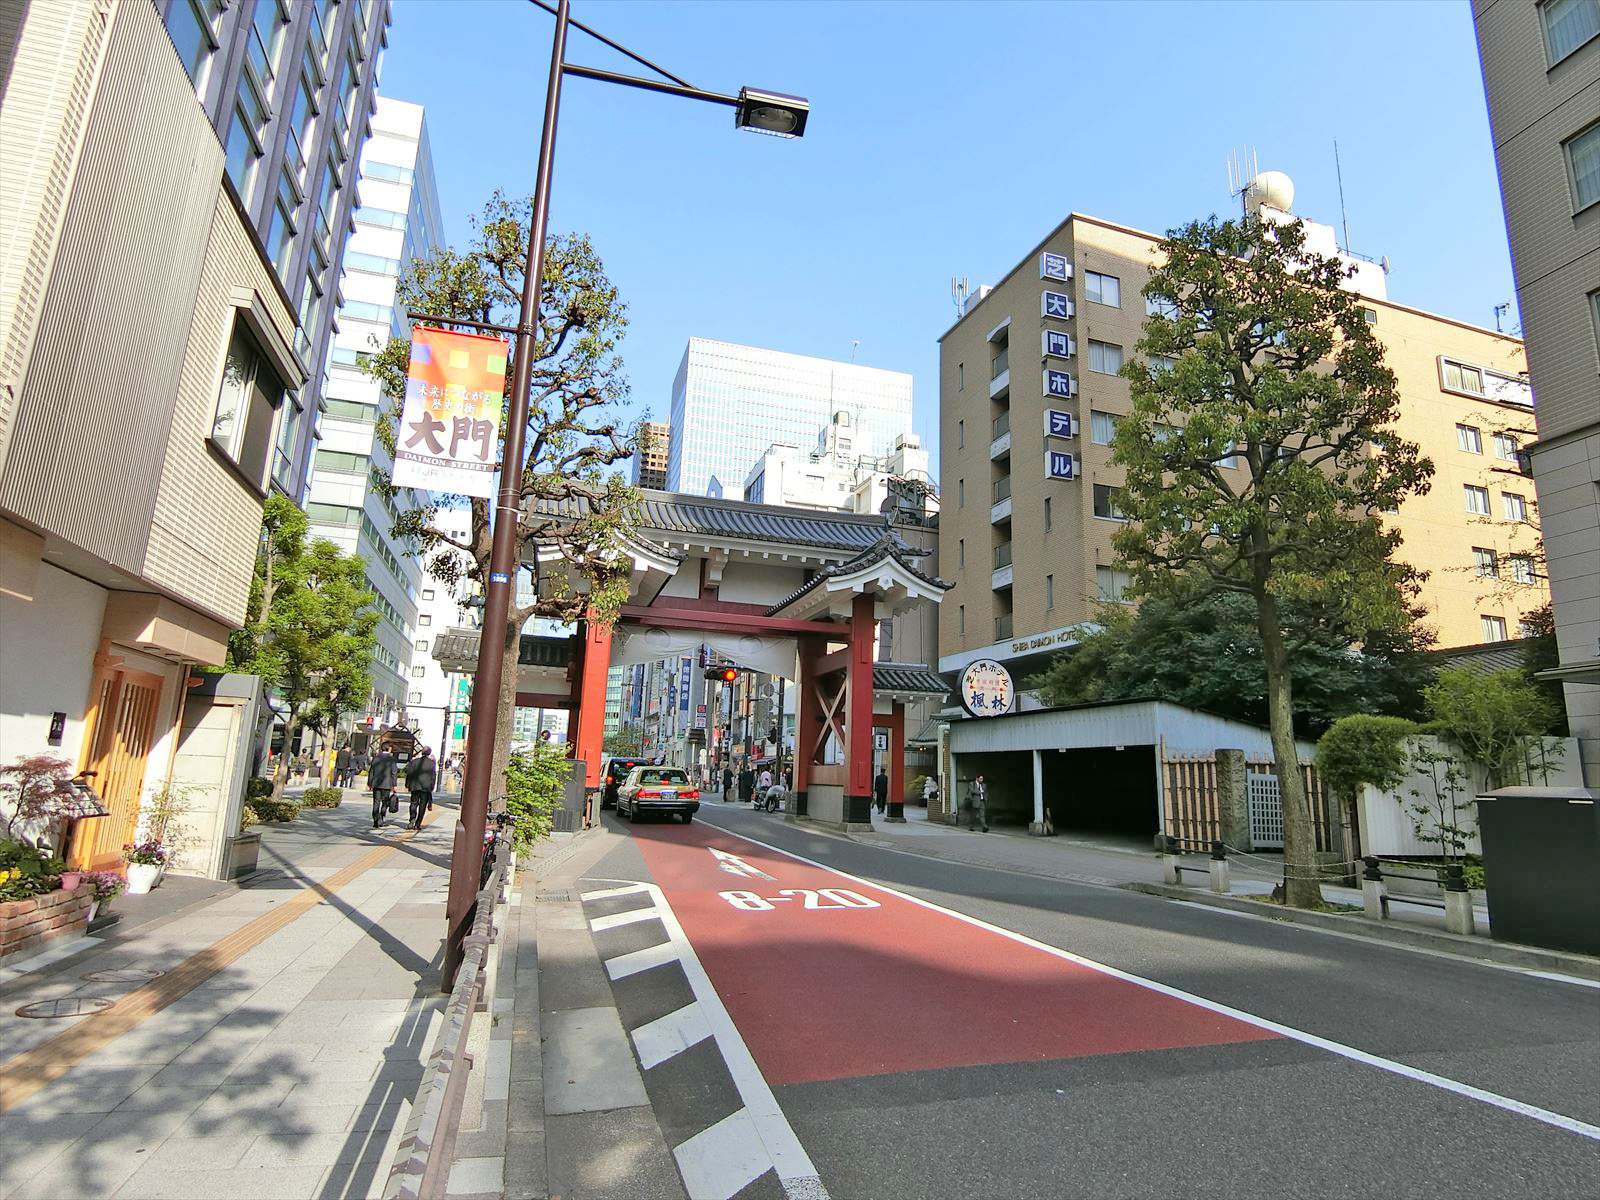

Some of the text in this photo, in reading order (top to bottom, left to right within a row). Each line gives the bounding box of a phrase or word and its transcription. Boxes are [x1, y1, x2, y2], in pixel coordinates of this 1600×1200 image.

[1047, 256, 1071, 476] 芝大門ホテル
[405, 411, 494, 462] 大門
[404, 452, 489, 472] DAIMON STREET
[1012, 641, 1030, 653] SHIBA
[1031, 635, 1056, 649] DAIMON
[970, 691, 1007, 711] 楓林
[718, 888, 882, 911] 8-20
